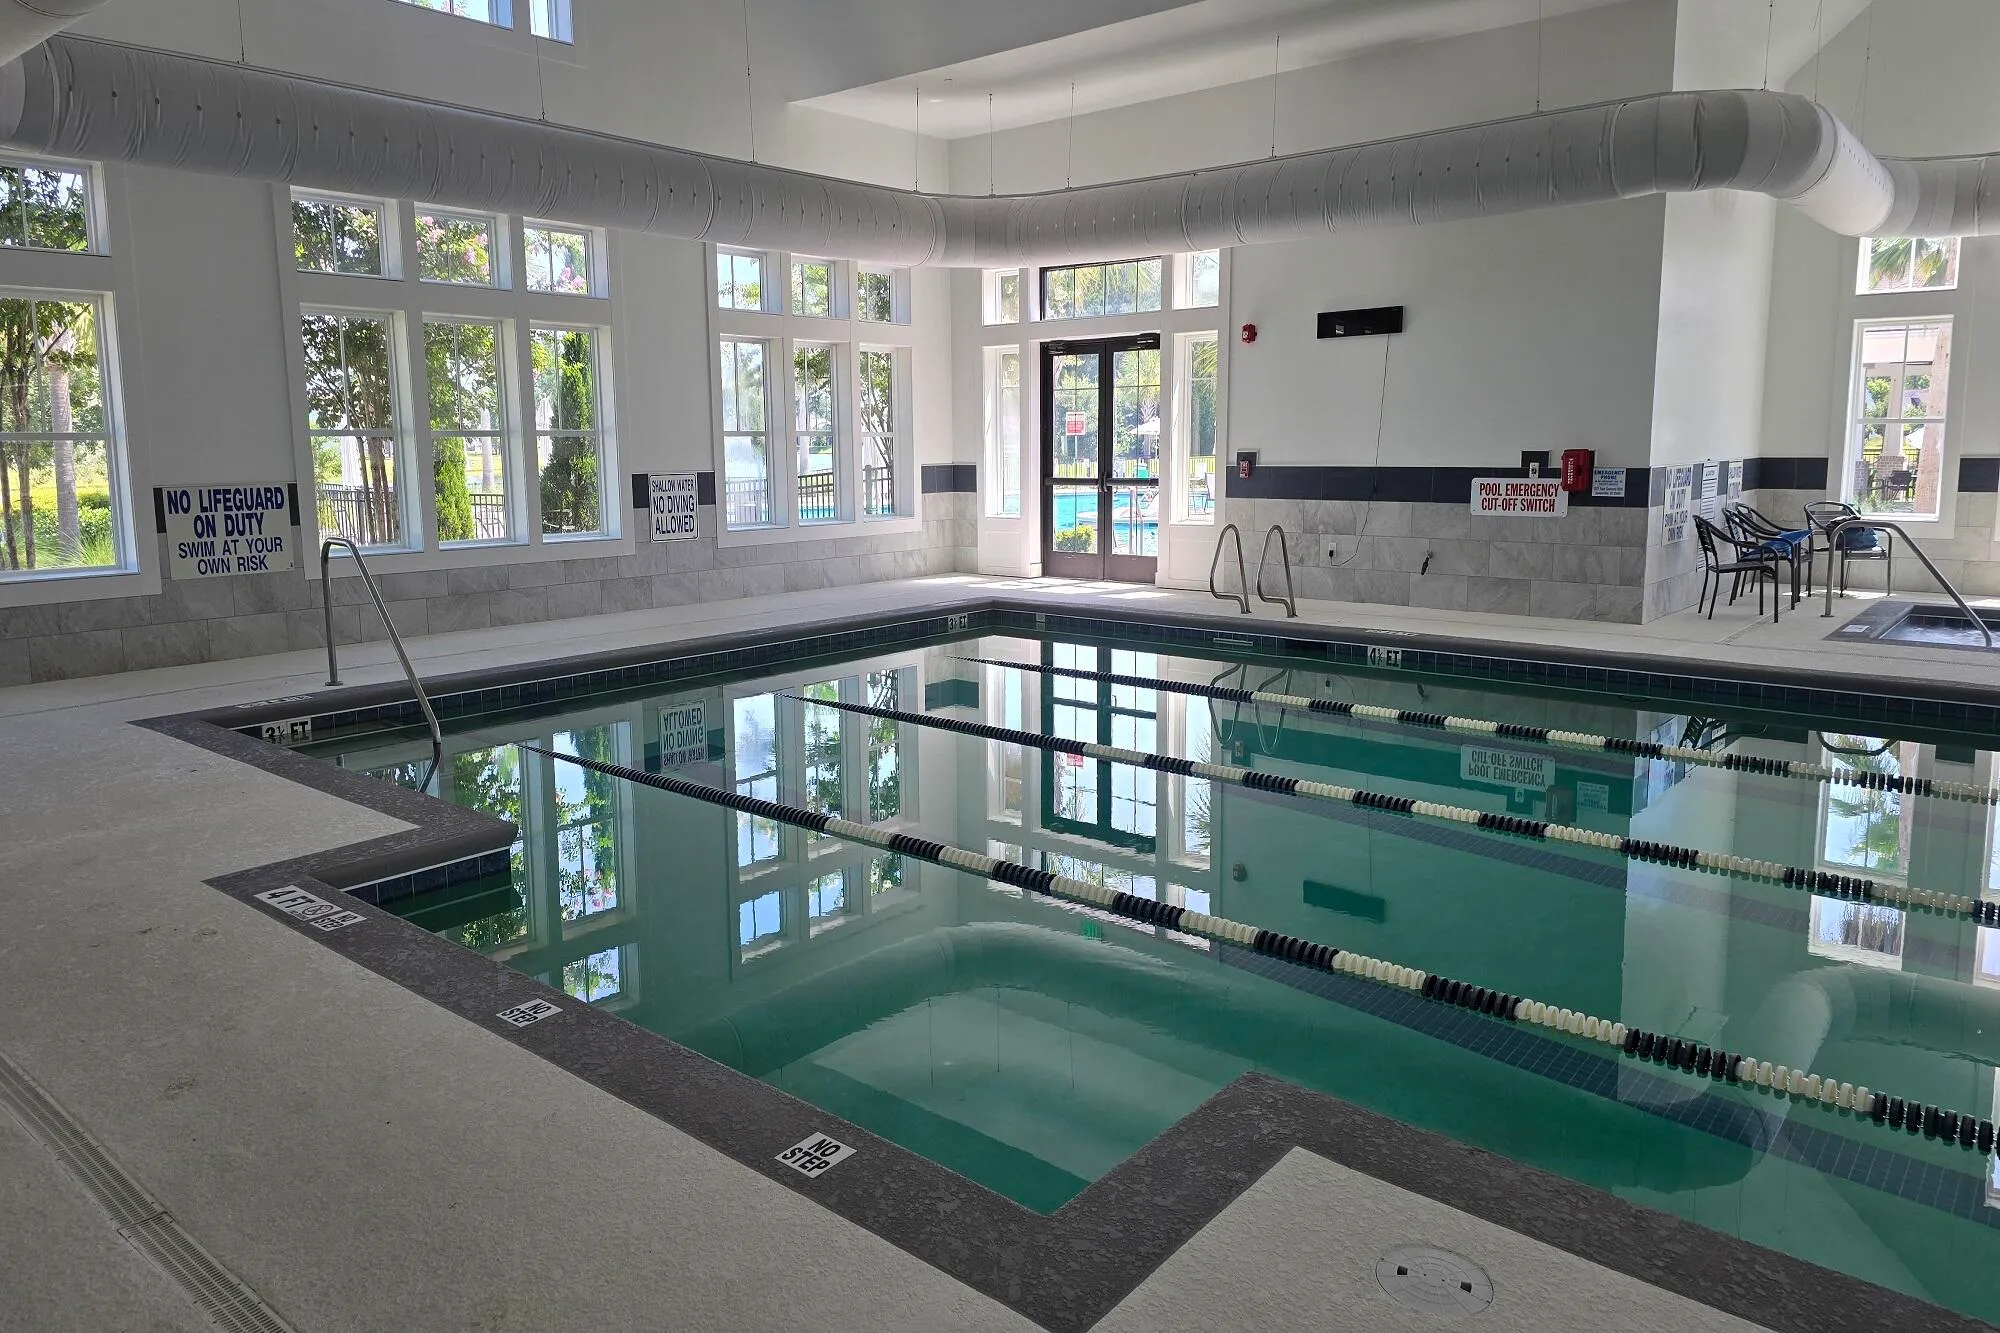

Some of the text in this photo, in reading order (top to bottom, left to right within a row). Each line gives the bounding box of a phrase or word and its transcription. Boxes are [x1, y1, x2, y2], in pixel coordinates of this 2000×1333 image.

[652, 479, 694, 492] SHALLOW WATER
[1480, 483, 1559, 497] POOL EMERGENCY
[166, 486, 285, 514] NO LIFEGUARD
[653, 495, 694, 514] NO DIVING
[1481, 498, 1555, 512] CUT-OFF SWITCH
[193, 512, 264, 538] ON DUTY
[656, 515, 695, 534] ALLOWED
[178, 537, 283, 559] SWIM AT YOUR
[198, 558, 231, 575] OWN
[237, 555, 269, 572] RISK
[290, 721, 309, 737] FT
[267, 890, 317, 909] 4 FT
[334, 913, 358, 923] NO
[500, 1008, 538, 1024] STEP
[524, 1002, 552, 1014] NO
[807, 1138, 841, 1158] NO
[781, 1147, 831, 1173] STEP
